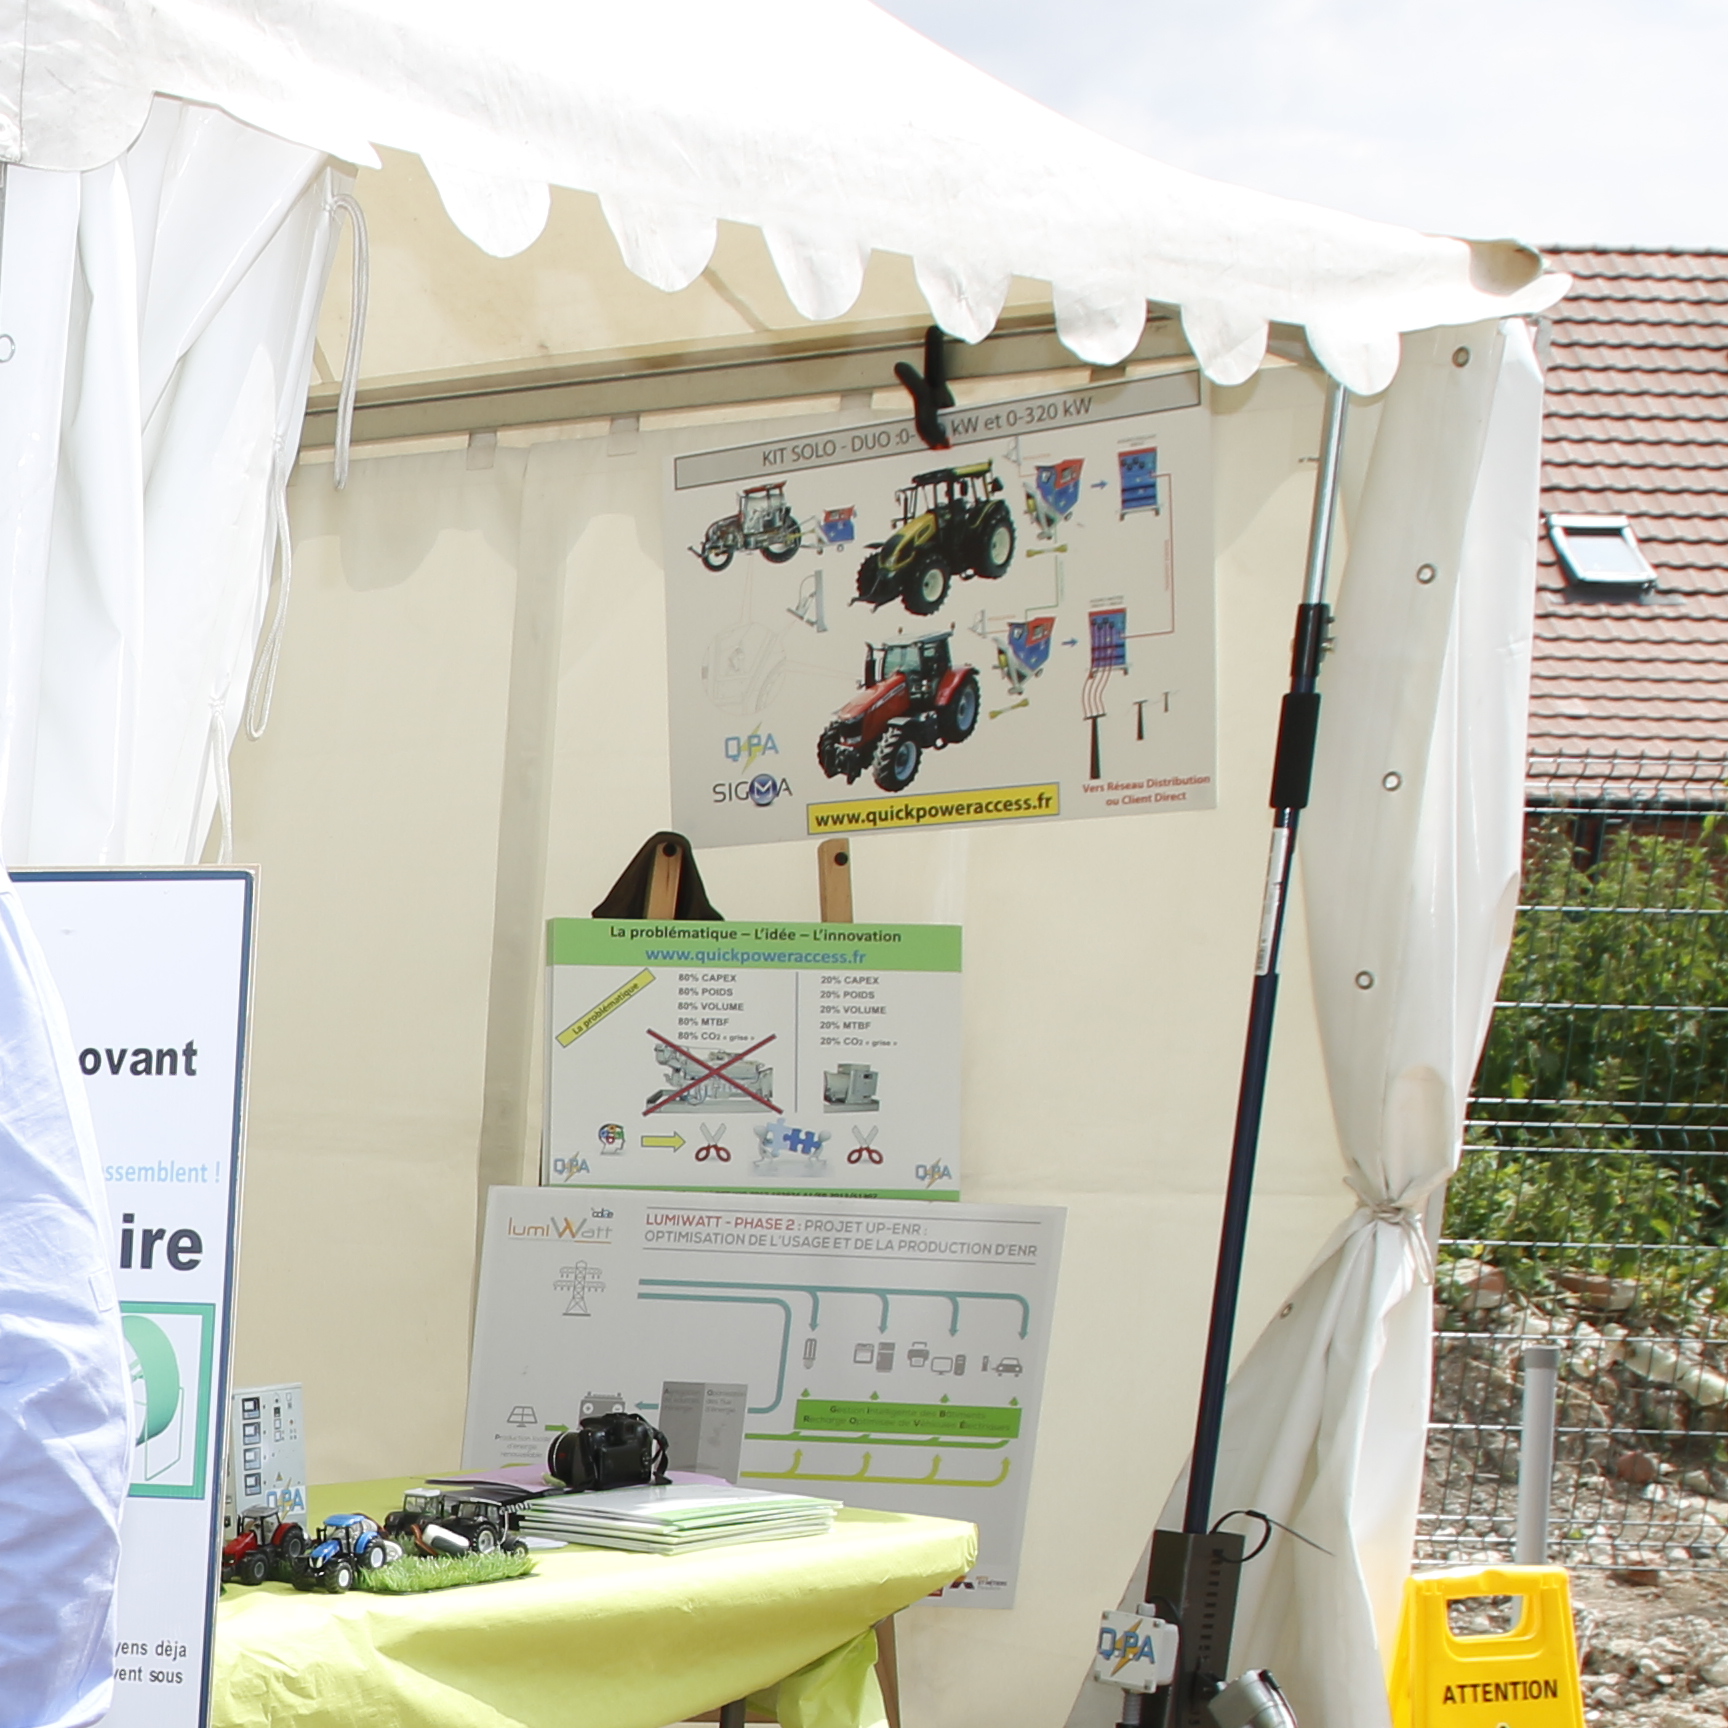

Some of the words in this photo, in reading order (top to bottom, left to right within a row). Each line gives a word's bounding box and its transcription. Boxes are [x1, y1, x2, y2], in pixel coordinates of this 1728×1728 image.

[762, 447, 786, 467] KIT
[791, 439, 837, 463] SOLO
[851, 432, 891, 452] DUO
[951, 416, 980, 437] kW
[984, 411, 1002, 430] et
[1007, 402, 1059, 428] 0-320
[1064, 397, 1093, 416] kW
[815, 792, 1053, 828] www.quickpoweraccess.fr
[610, 926, 626, 938] La
[631, 925, 737, 942] problématique
[813, 929, 901, 943] L'innovation
[645, 948, 866, 965] www.quickpoweraccess.fr
[79, 1040, 198, 1077] ovant
[105, 1160, 208, 1185] ssemblent
[646, 1214, 722, 1228] LUMIWATT
[734, 1217, 782, 1231] PHASE
[785, 1219, 795, 1231] 2
[804, 1220, 862, 1234] PROJET
[866, 1222, 921, 1236] UP-ENR
[119, 1213, 203, 1271] ire
[645, 1230, 744, 1246] OPTIMISATION
[749, 1233, 766, 1246] DE
[770, 1235, 830, 1249] L'USAGE
[833, 1237, 851, 1250] ET
[854, 1238, 874, 1250] DE
[876, 1238, 894, 1251] LA
[898, 1240, 992, 1256] PRODUCTION
[995, 1244, 1038, 1258] D'ENR
[149, 1668, 183, 1684] sous
[1442, 1678, 1559, 1706] ATTENTION
